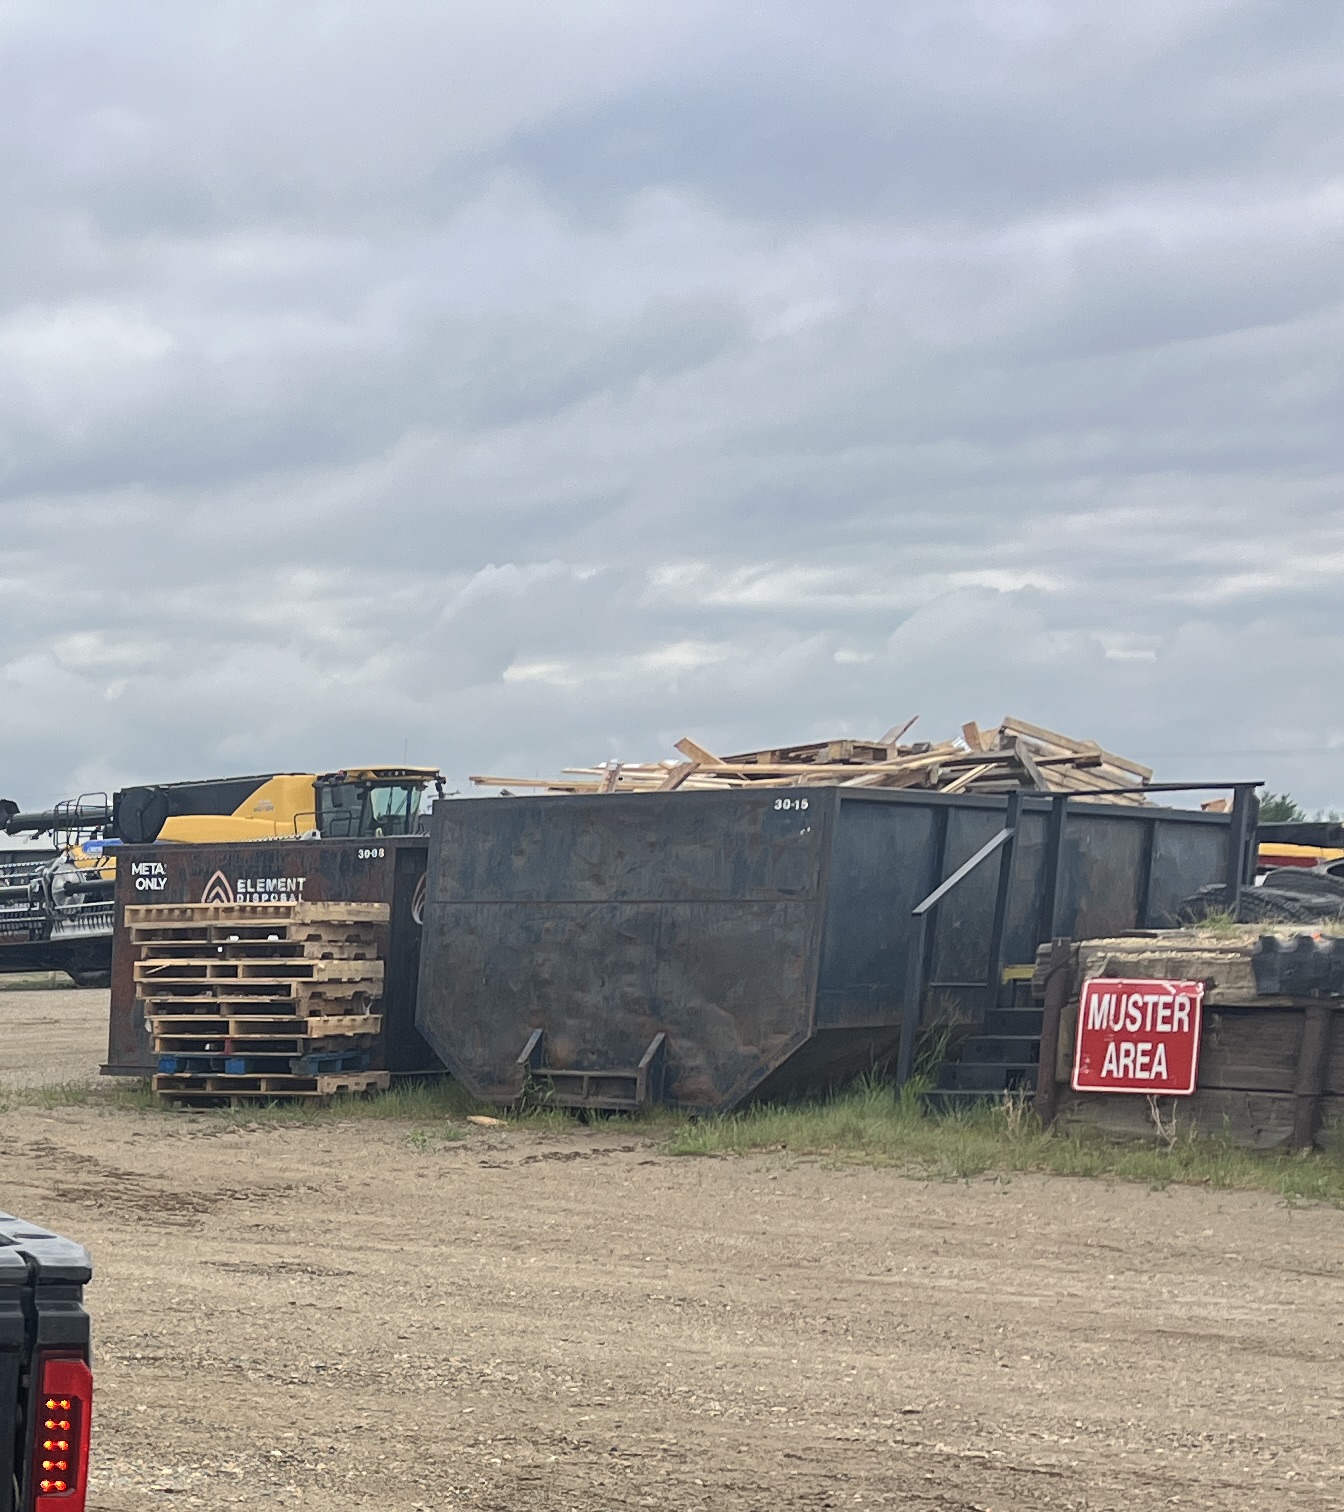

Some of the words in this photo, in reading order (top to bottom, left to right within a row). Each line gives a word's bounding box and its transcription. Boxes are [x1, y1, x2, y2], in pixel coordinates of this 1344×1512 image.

[135, 877, 168, 891] ONLY
[237, 877, 307, 893] ELEMENT
[236, 893, 305, 903] DISPOSAL
[1087, 993, 1191, 1032] MUSTER
[1100, 1041, 1168, 1080] AREA
